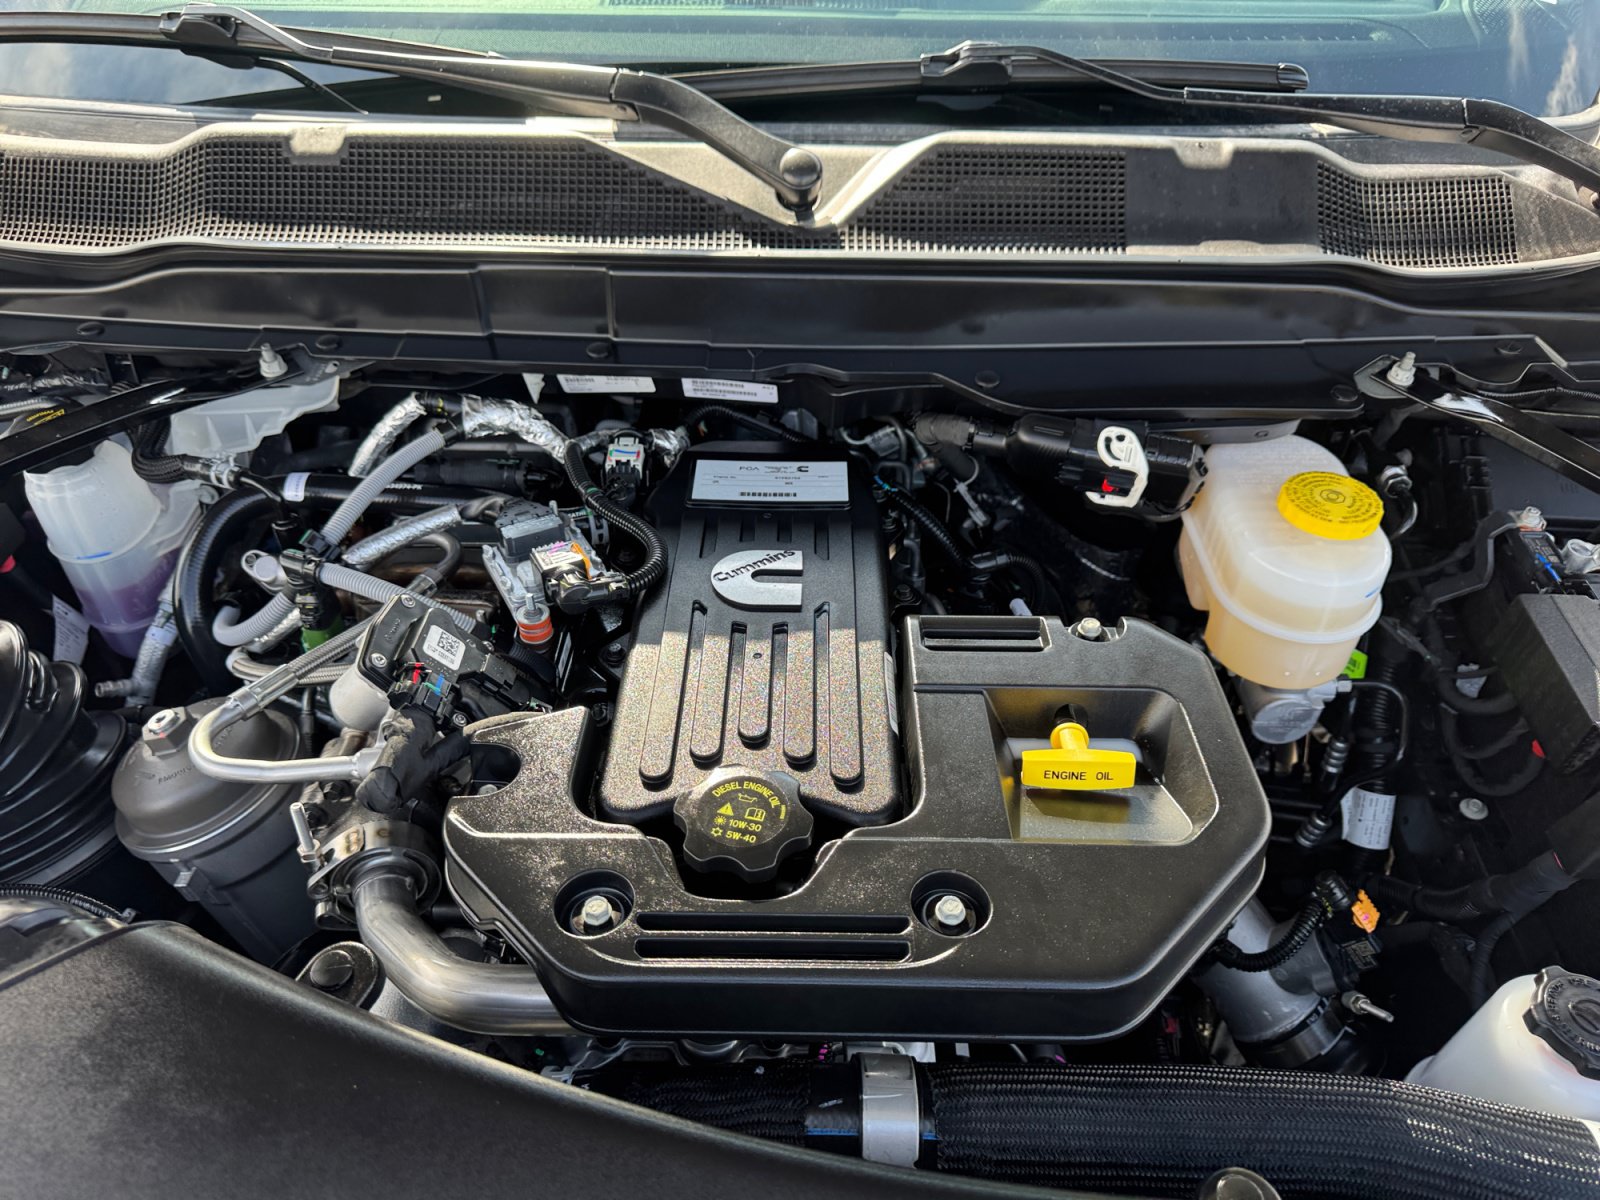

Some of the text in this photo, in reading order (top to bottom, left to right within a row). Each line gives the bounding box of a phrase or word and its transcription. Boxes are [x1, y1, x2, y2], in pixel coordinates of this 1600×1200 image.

[713, 550, 796, 581] Cummins
[1043, 770, 1113, 781] ENGINE OIL
[711, 781, 780, 808] DIESEL ENGINE OIL
[729, 819, 762, 832] 10W-30
[726, 830, 757, 843] 5W-40
